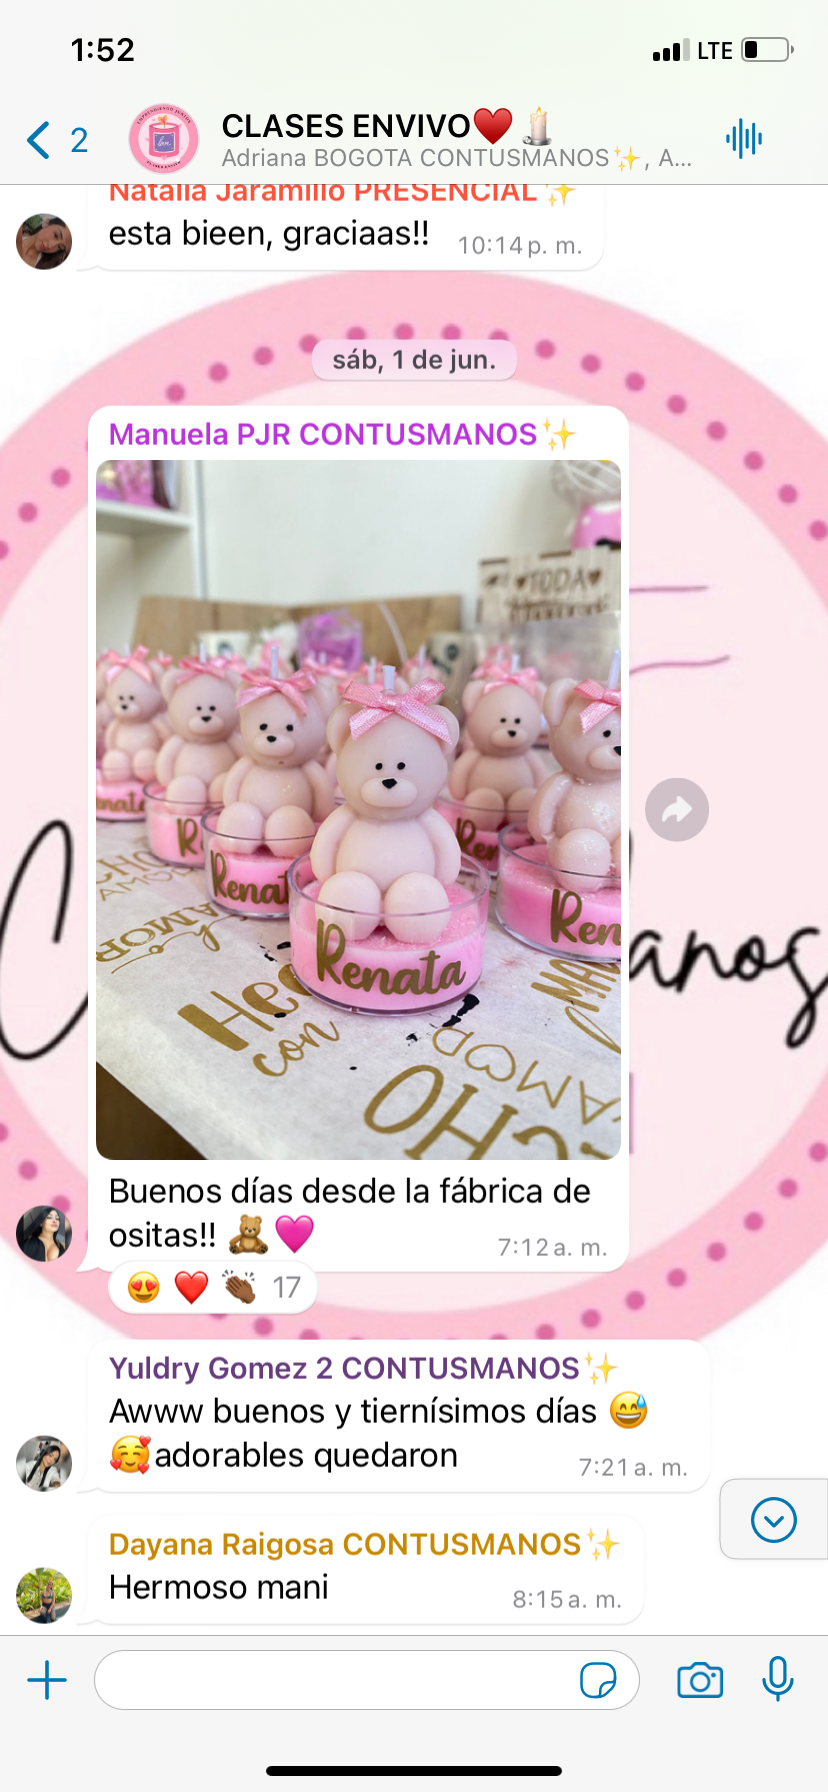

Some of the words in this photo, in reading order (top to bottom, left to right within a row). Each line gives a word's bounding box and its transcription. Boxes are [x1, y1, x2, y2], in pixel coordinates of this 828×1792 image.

[71, 37, 135, 63] 1:52
[698, 41, 733, 60] LTE
[70, 126, 88, 153] 2
[222, 113, 344, 139] CLASES
[353, 113, 471, 139] ENVIVO
[221, 147, 306, 167] Adriana
[314, 148, 413, 168] BOGOTA
[354, 185, 538, 202] PRESENCIAL
[108, 220, 172, 247] esta
[182, 218, 273, 252] bieen,
[282, 218, 429, 253] graciaas!!
[332, 347, 384, 375] sáb,
[392, 349, 403, 370] 1
[412, 348, 443, 370] de
[448, 347, 496, 375] jun.
[109, 421, 228, 446] Manuela
[237, 422, 291, 446] PJR
[299, 422, 537, 446] CONTUSMANOS
[551, 888, 622, 946] Ren
[315, 918, 468, 996] Renata
[252, 1020, 340, 1077] con
[110, 1177, 222, 1205] Buenos
[230, 1175, 293, 1205] días
[301, 1176, 396, 1205] desde
[406, 1176, 430, 1205] la
[439, 1175, 543, 1205] fábrica
[553, 1176, 591, 1205] de
[108, 1220, 216, 1249] ositas!!
[273, 1275, 302, 1299] 17
[108, 1355, 200, 1387] Yuldry
[208, 1355, 308, 1381] Gomez
[316, 1355, 333, 1380] 2
[341, 1355, 580, 1381] CONTUSMANOS
[108, 1397, 204, 1425] Awww
[213, 1396, 325, 1425] buenos
[334, 1403, 352, 1431] y
[360, 1395, 526, 1425] tiernísimos
[535, 1395, 597, 1425] días
[154, 1440, 304, 1469] adorables
[313, 1440, 458, 1474] quedaron
[109, 1532, 213, 1563] Dayana
[222, 1530, 334, 1563] Raigosa
[343, 1532, 581, 1557] CONTUSMANOS
[110, 1573, 248, 1601] Hermoso
[257, 1572, 328, 1601] mani
